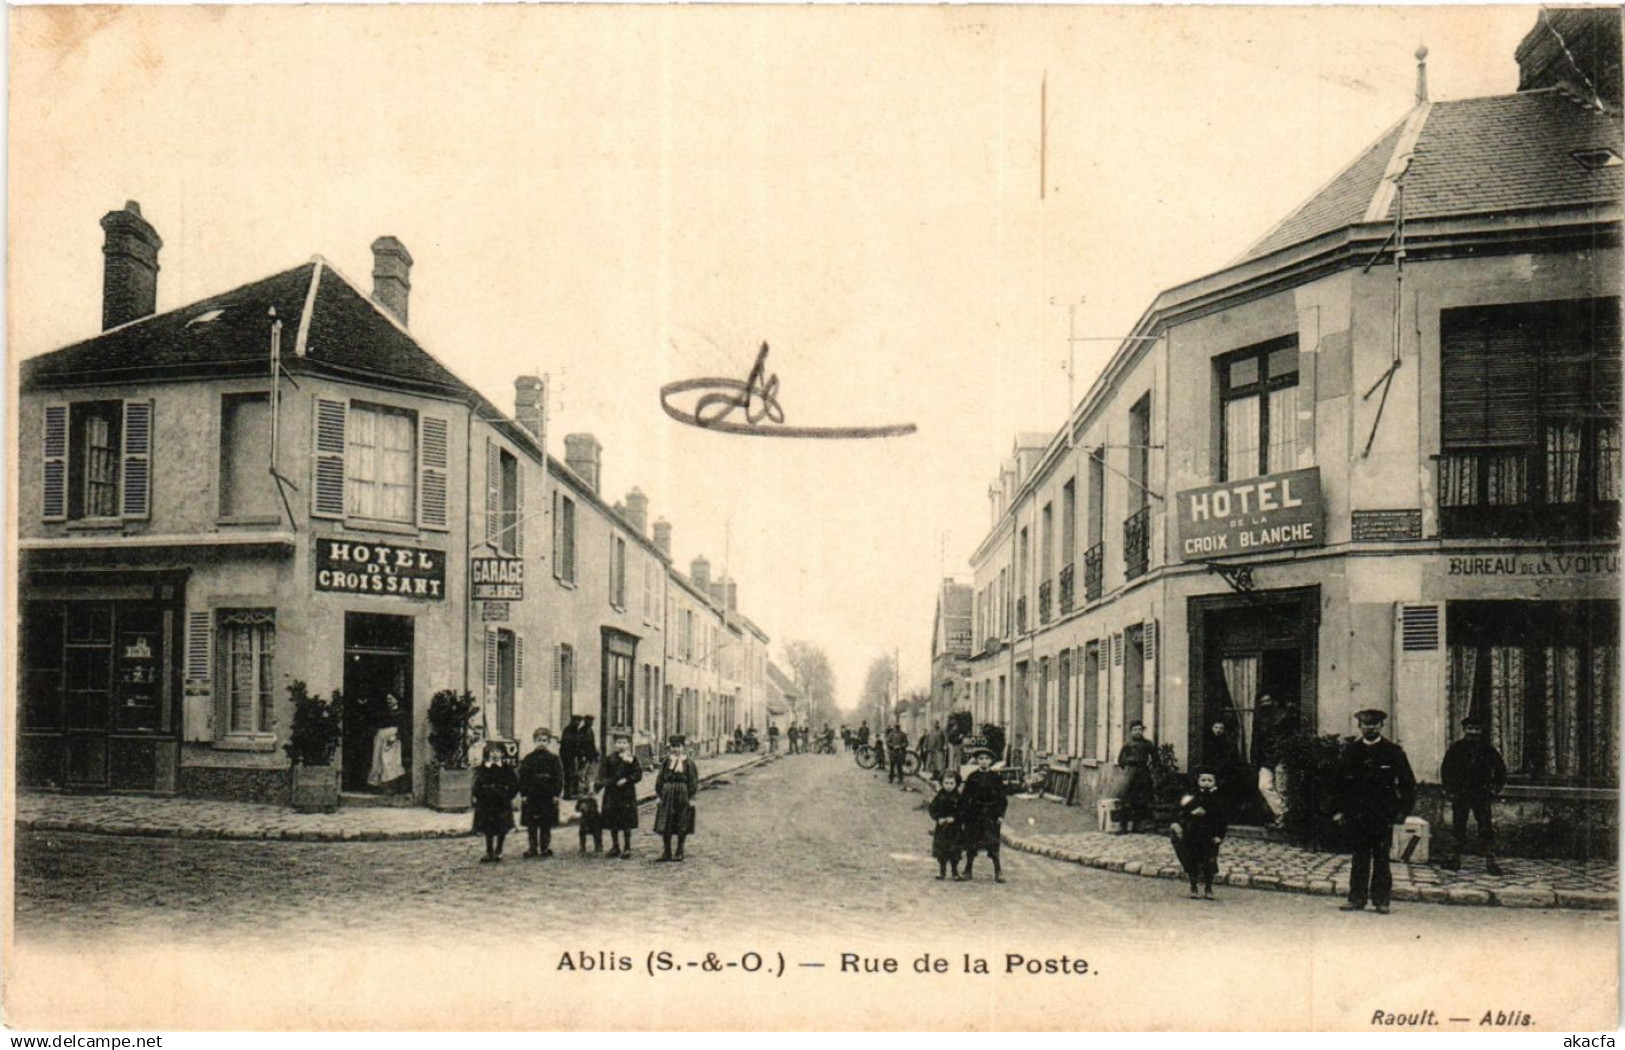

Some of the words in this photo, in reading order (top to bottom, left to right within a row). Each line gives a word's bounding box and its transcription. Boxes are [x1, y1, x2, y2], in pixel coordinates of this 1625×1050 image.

[1190, 478, 1302, 522] HOTEL
[1229, 519, 1245, 528] DE
[1251, 515, 1268, 525] LA
[1184, 534, 1228, 554] CROIX
[1239, 522, 1314, 548] BLANCHE
[329, 543, 434, 570] HOTEL
[366, 563, 399, 575] DU
[1448, 556, 1517, 576] BUREAU
[318, 569, 442, 595] CROISSANT
[473, 560, 524, 584] GARAGE
